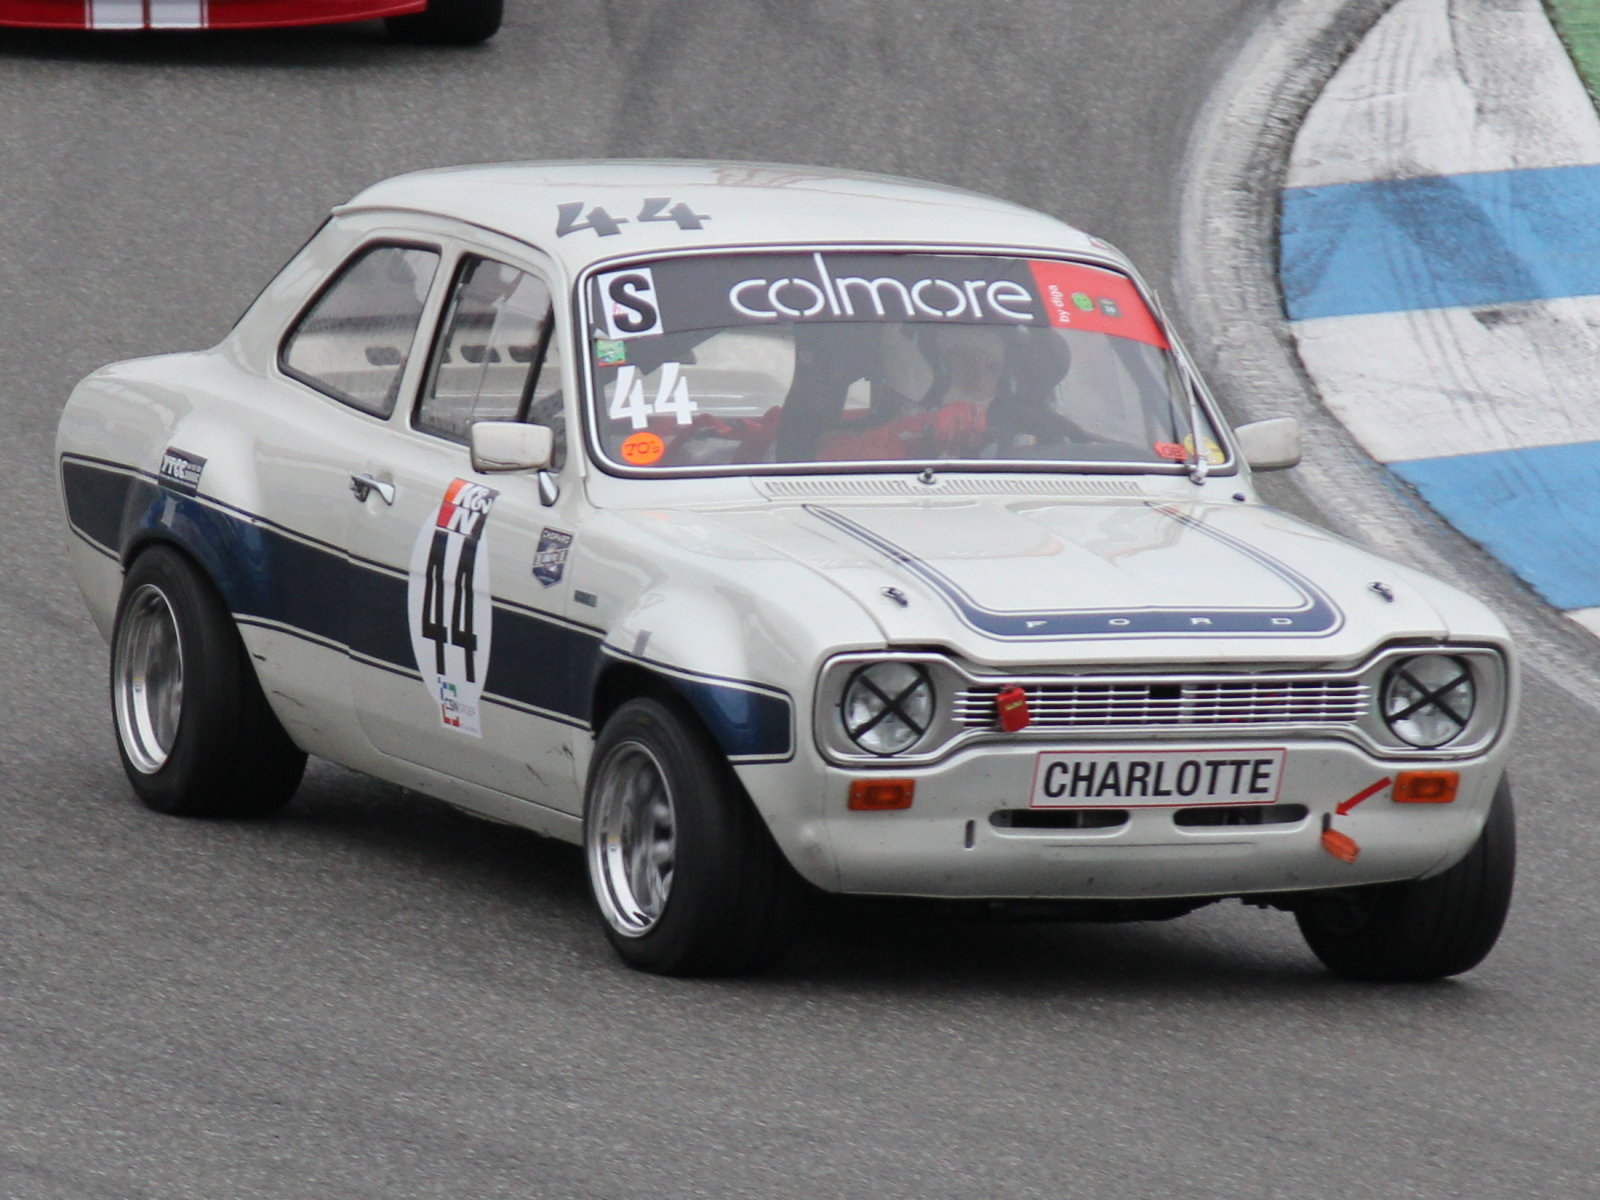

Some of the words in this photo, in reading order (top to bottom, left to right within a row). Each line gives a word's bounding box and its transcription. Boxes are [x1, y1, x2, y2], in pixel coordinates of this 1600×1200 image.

[556, 197, 711, 238] 44
[609, 273, 657, 332] S
[729, 252, 1034, 320] colmore
[610, 362, 698, 429] 44
[422, 529, 477, 683] 44
[1025, 616, 1293, 629] FORD
[1043, 758, 1274, 798] CHARLOTTE
